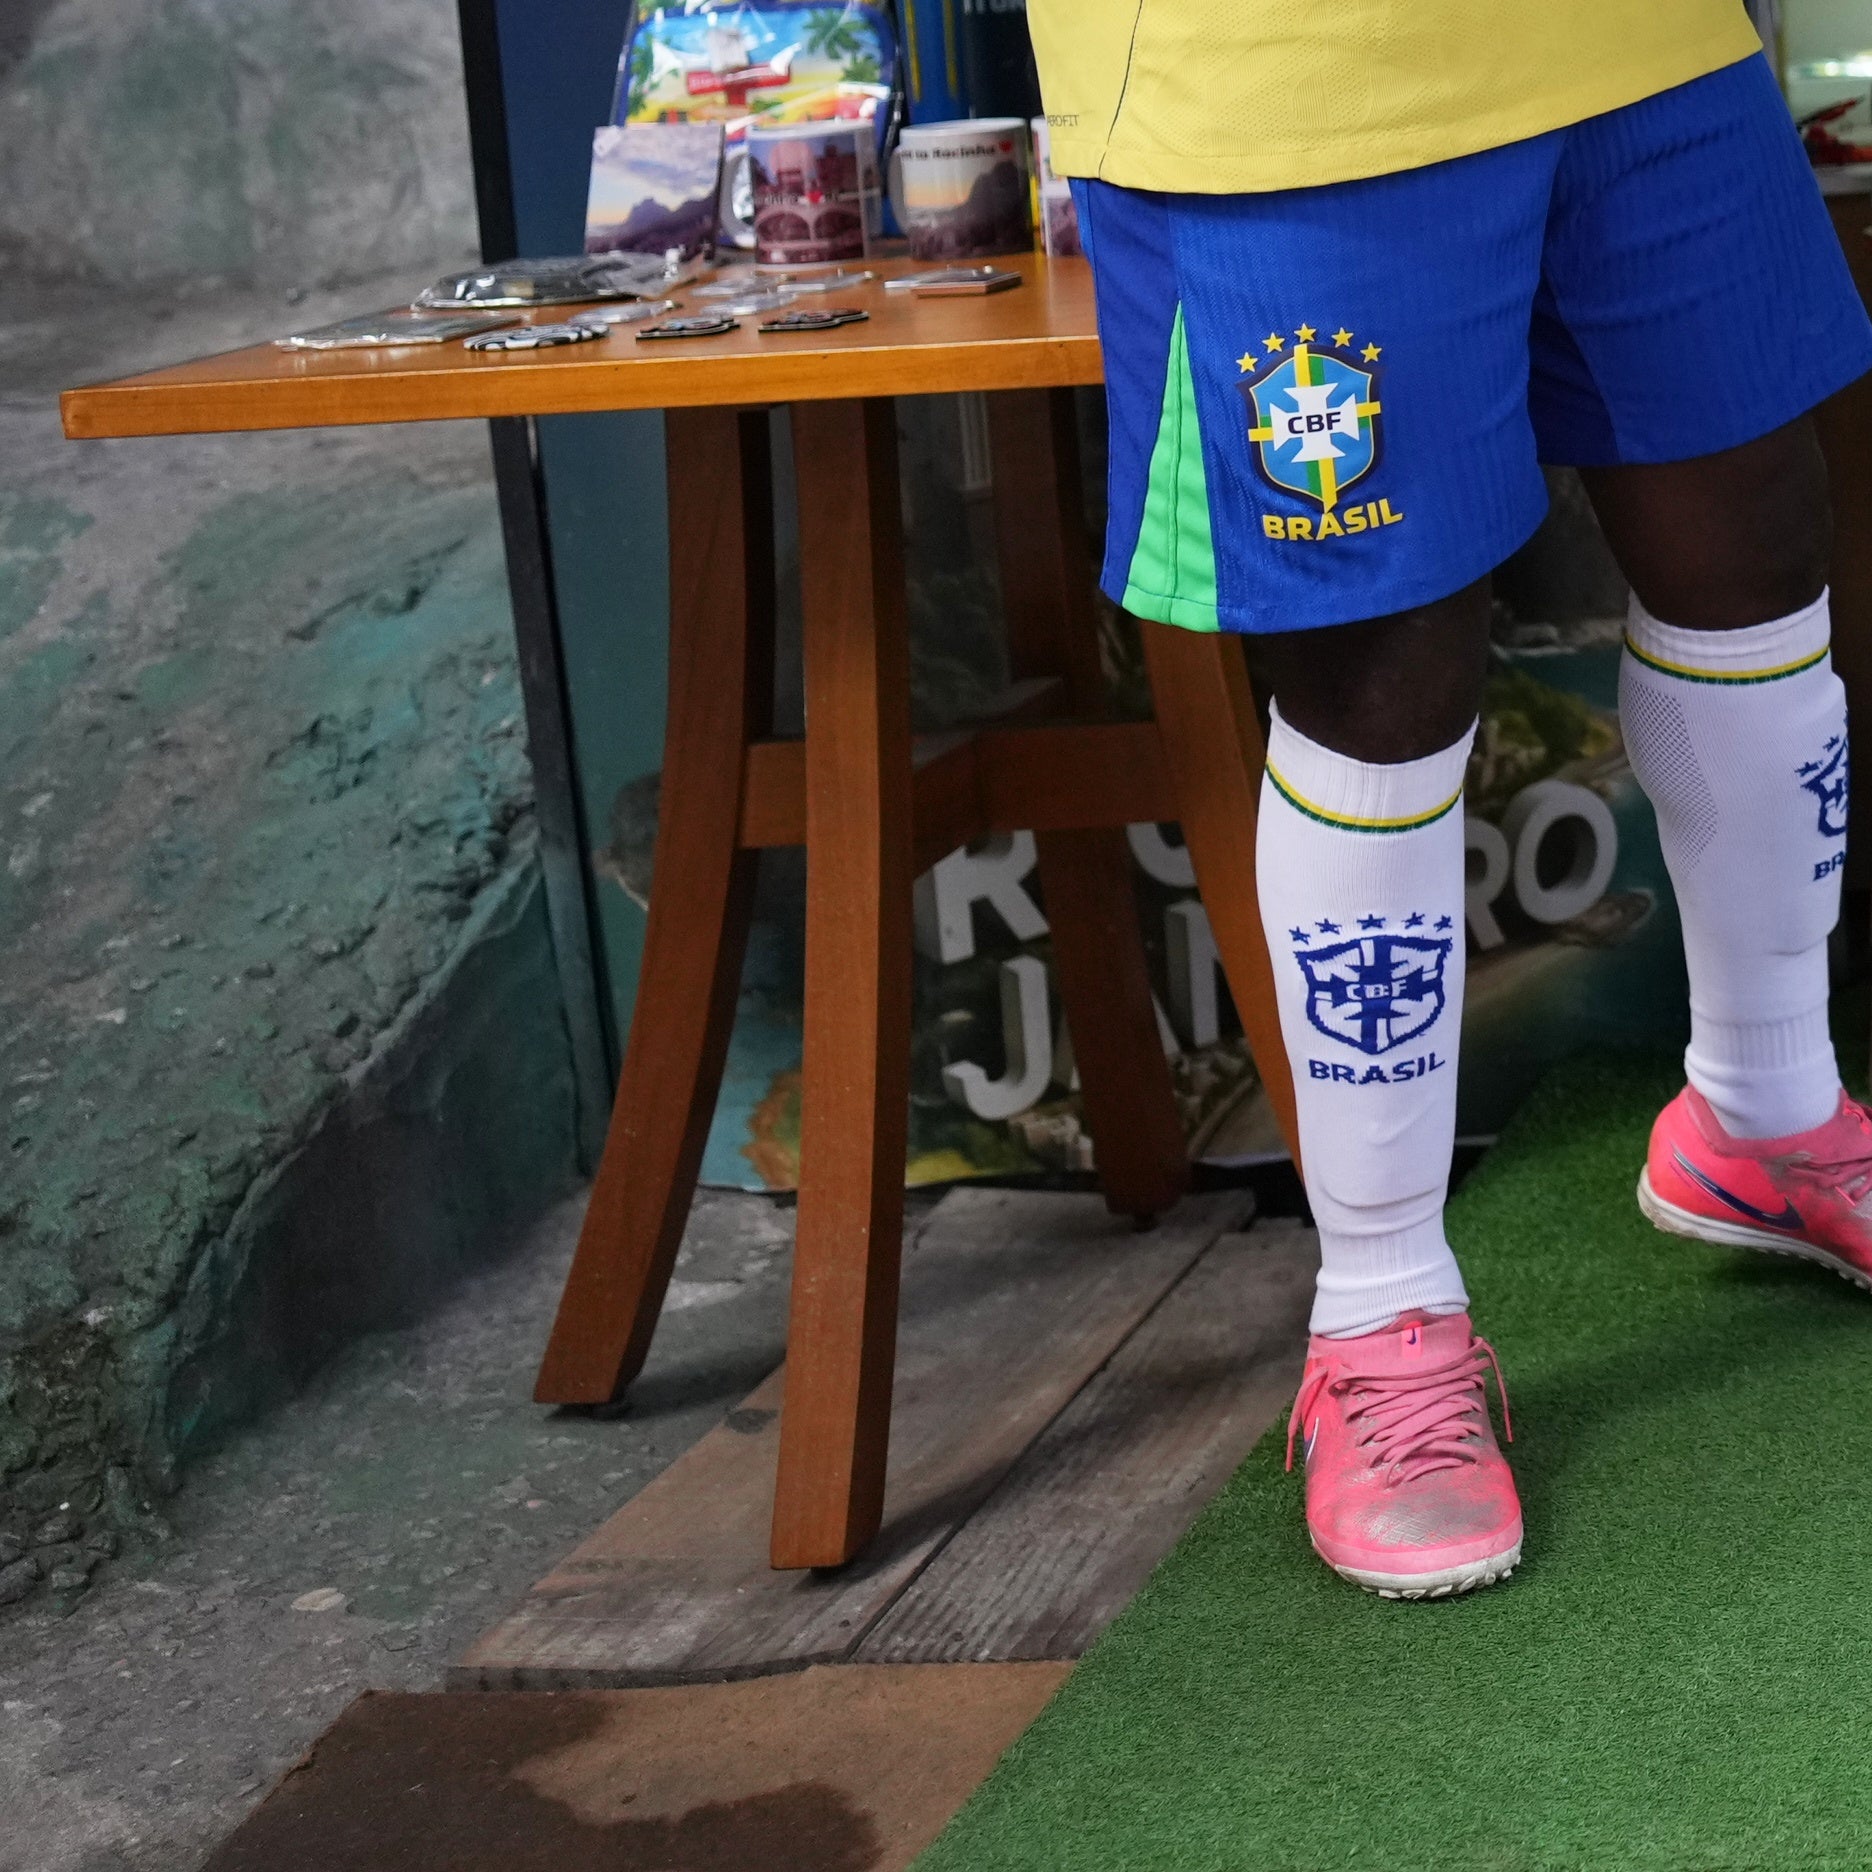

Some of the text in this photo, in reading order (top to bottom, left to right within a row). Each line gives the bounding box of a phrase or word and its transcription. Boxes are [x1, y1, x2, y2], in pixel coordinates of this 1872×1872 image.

[1287, 411, 1342, 435] CBF
[1261, 497, 1404, 542] BRASIL
[1308, 1051, 1447, 1086] BRASIL
